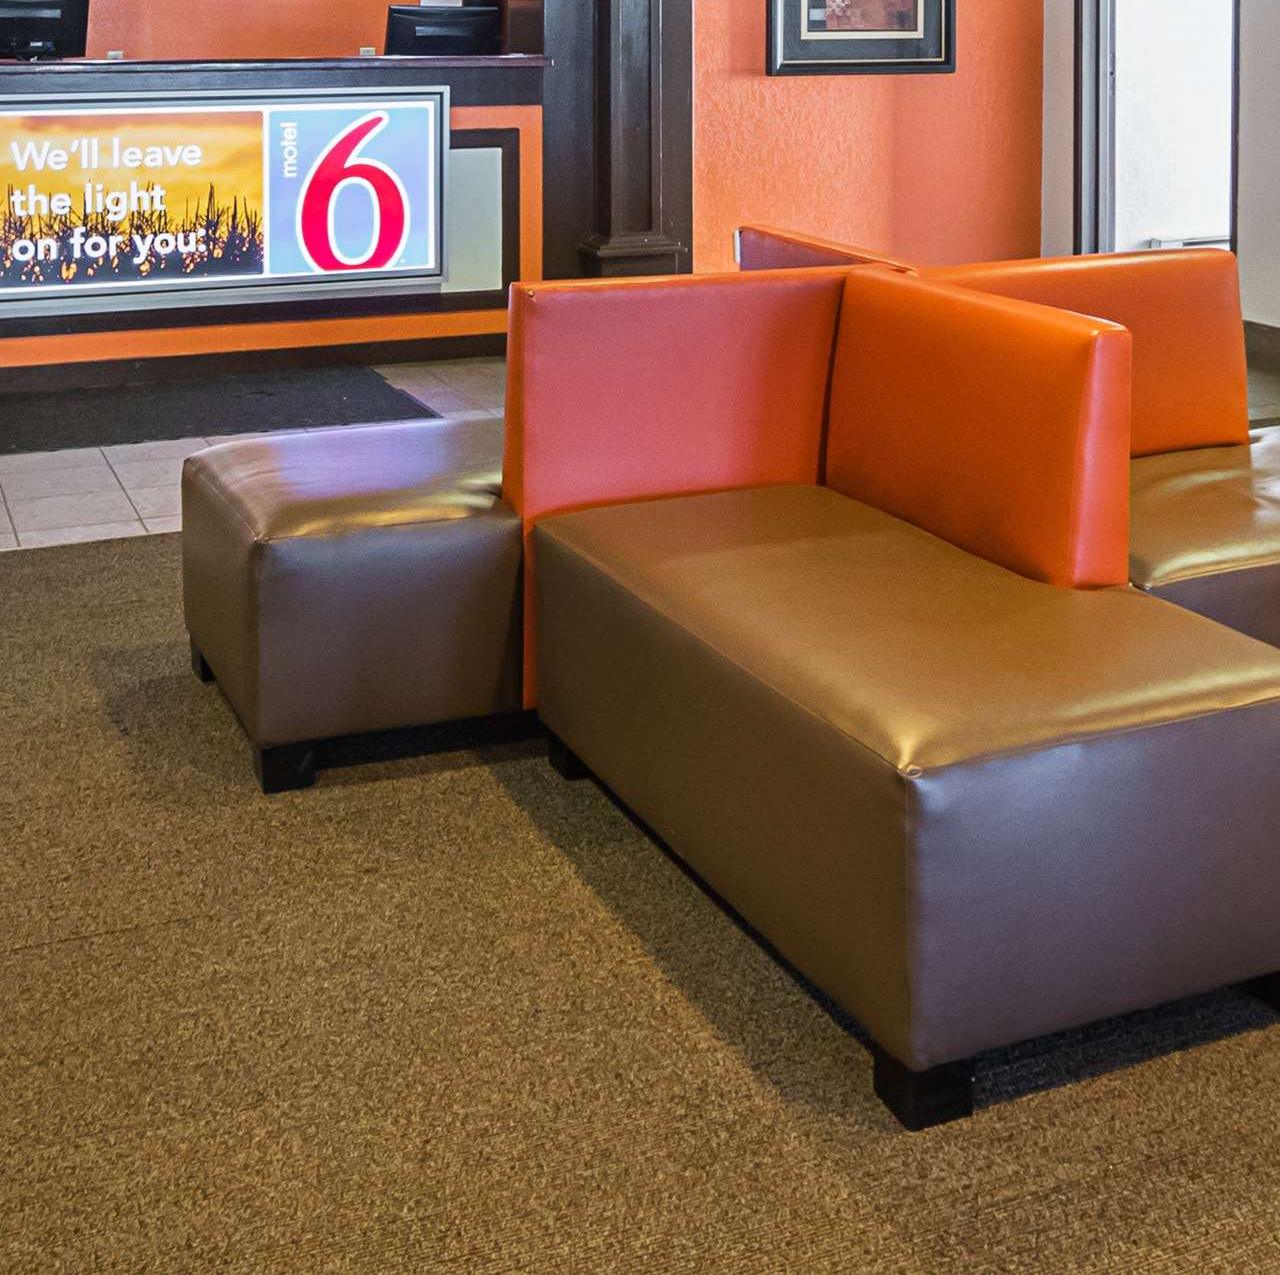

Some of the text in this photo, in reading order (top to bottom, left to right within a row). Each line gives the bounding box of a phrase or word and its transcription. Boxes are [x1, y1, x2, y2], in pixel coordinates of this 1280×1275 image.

[10, 137, 203, 171] We'll leave
[11, 180, 167, 222] the light
[280, 110, 411, 272] motel 6
[12, 236, 58, 261] on
[70, 226, 123, 258] for
